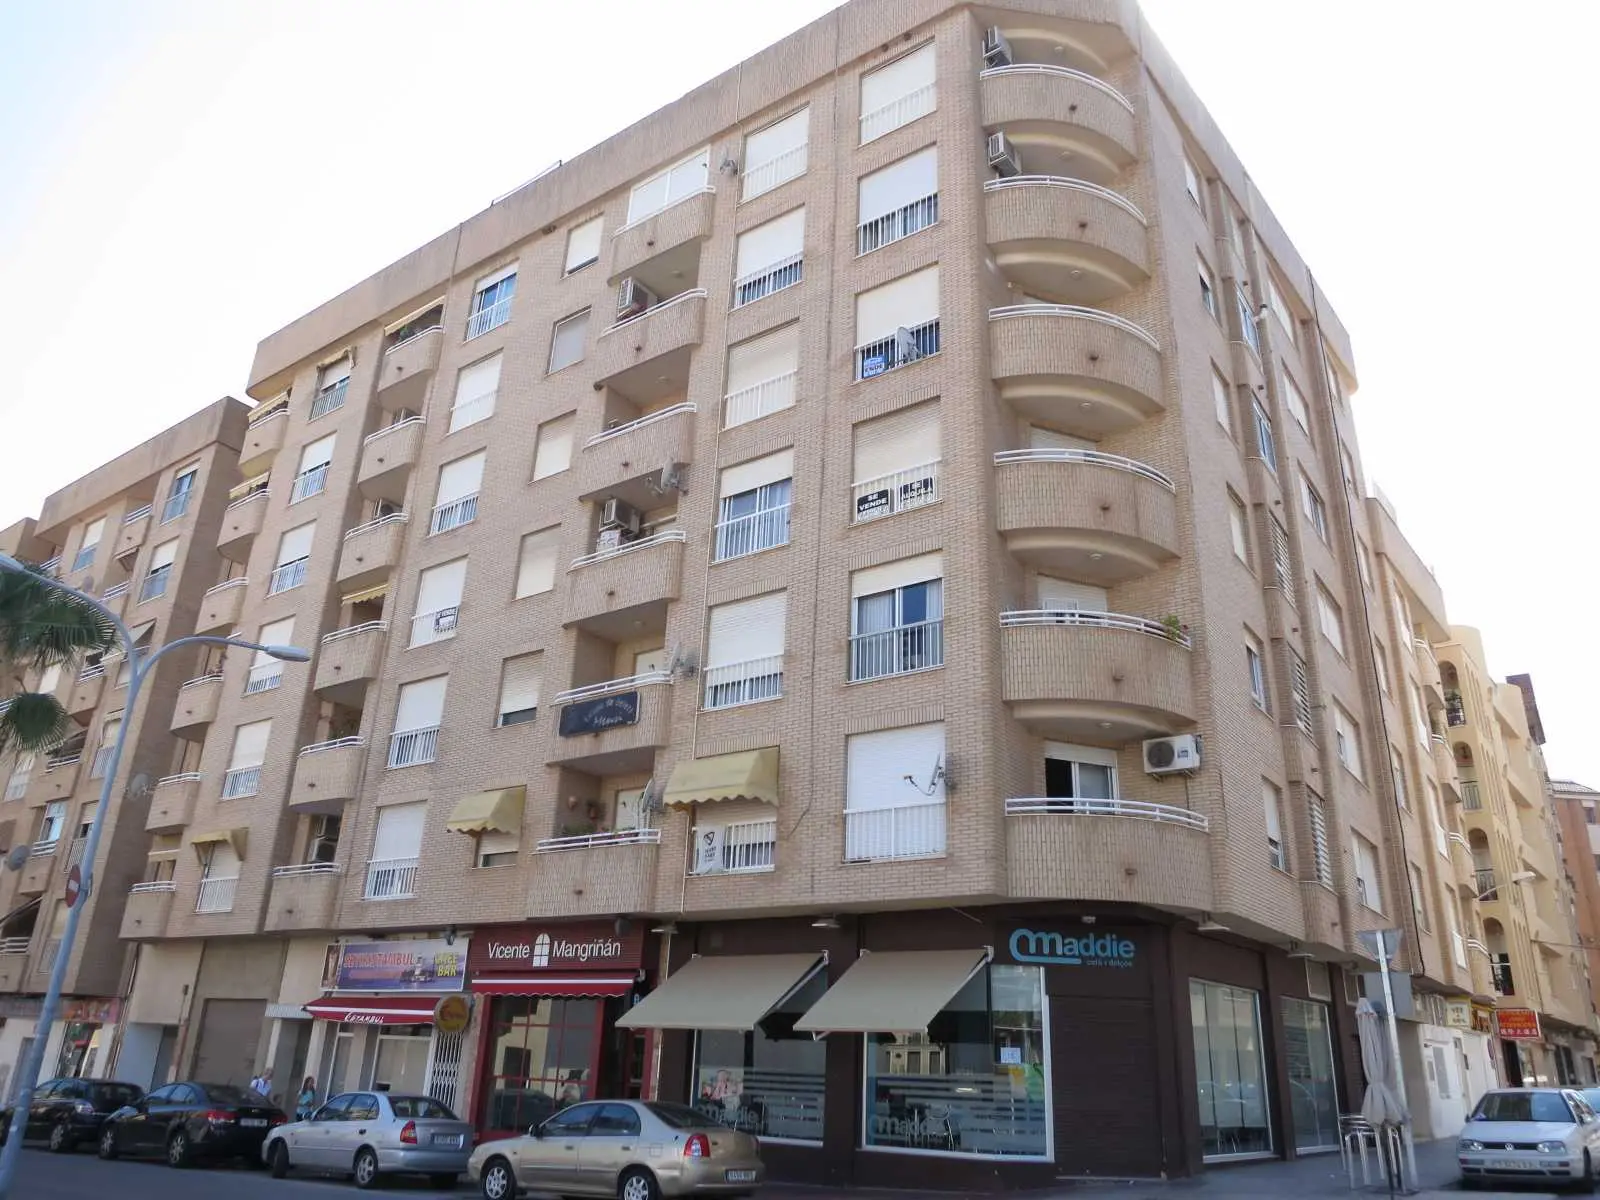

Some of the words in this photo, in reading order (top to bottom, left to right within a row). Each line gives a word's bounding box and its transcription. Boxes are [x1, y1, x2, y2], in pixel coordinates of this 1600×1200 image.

[868, 492, 879, 501] SE
[859, 497, 887, 511] VENDE
[488, 941, 530, 959] Vicente
[552, 938, 621, 961] Mangriñán
[1009, 928, 1135, 964] maddie
[437, 964, 457, 977] BAR
